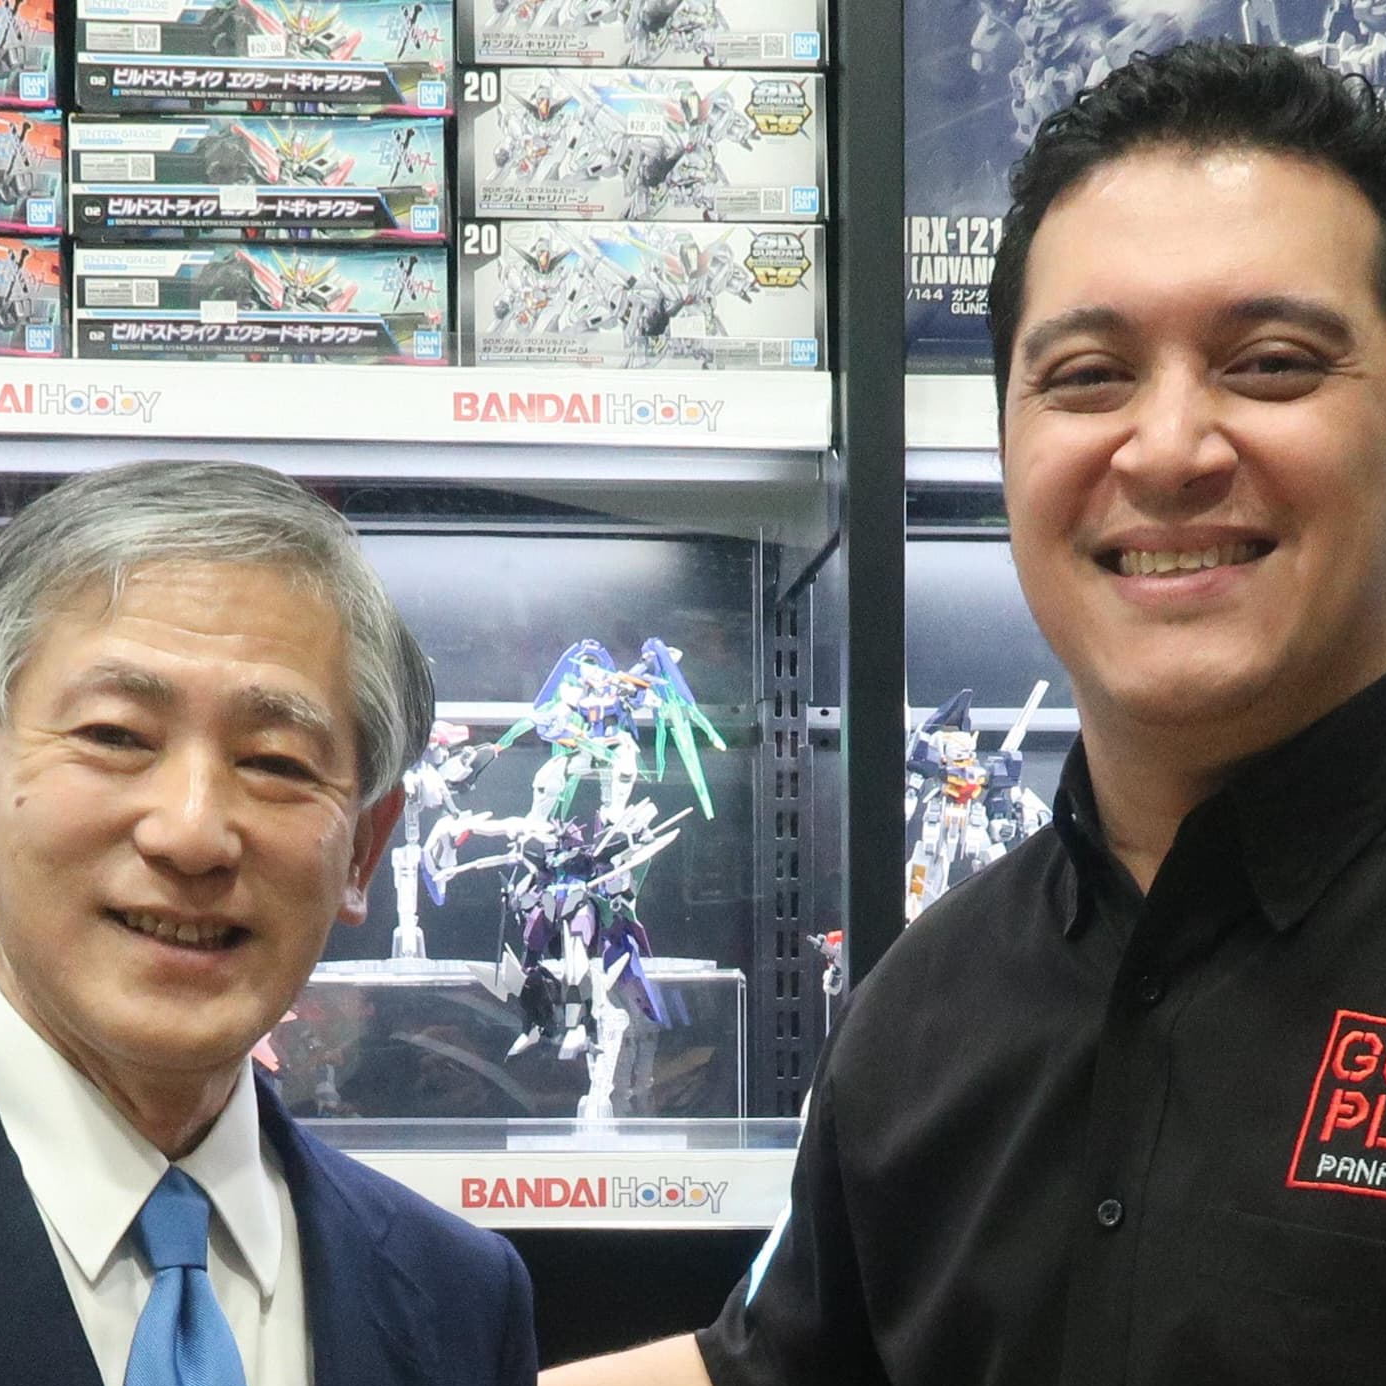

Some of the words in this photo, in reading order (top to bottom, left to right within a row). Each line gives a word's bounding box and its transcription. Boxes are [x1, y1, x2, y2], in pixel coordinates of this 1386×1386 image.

[113, 68, 224, 87] ビルドストライク
[227, 70, 381, 90] エクシードギャラクシー
[464, 72, 497, 102] 20
[464, 224, 497, 255] 20
[113, 323, 222, 341] ビルドストライク
[224, 324, 378, 344] エクシードギャラクシー
[39, 383, 161, 423] Hobby
[454, 392, 600, 424] BANDAI
[606, 392, 724, 431] Hobby
[461, 1177, 607, 1209] BANDAI
[613, 1176, 729, 1214] Hobby
